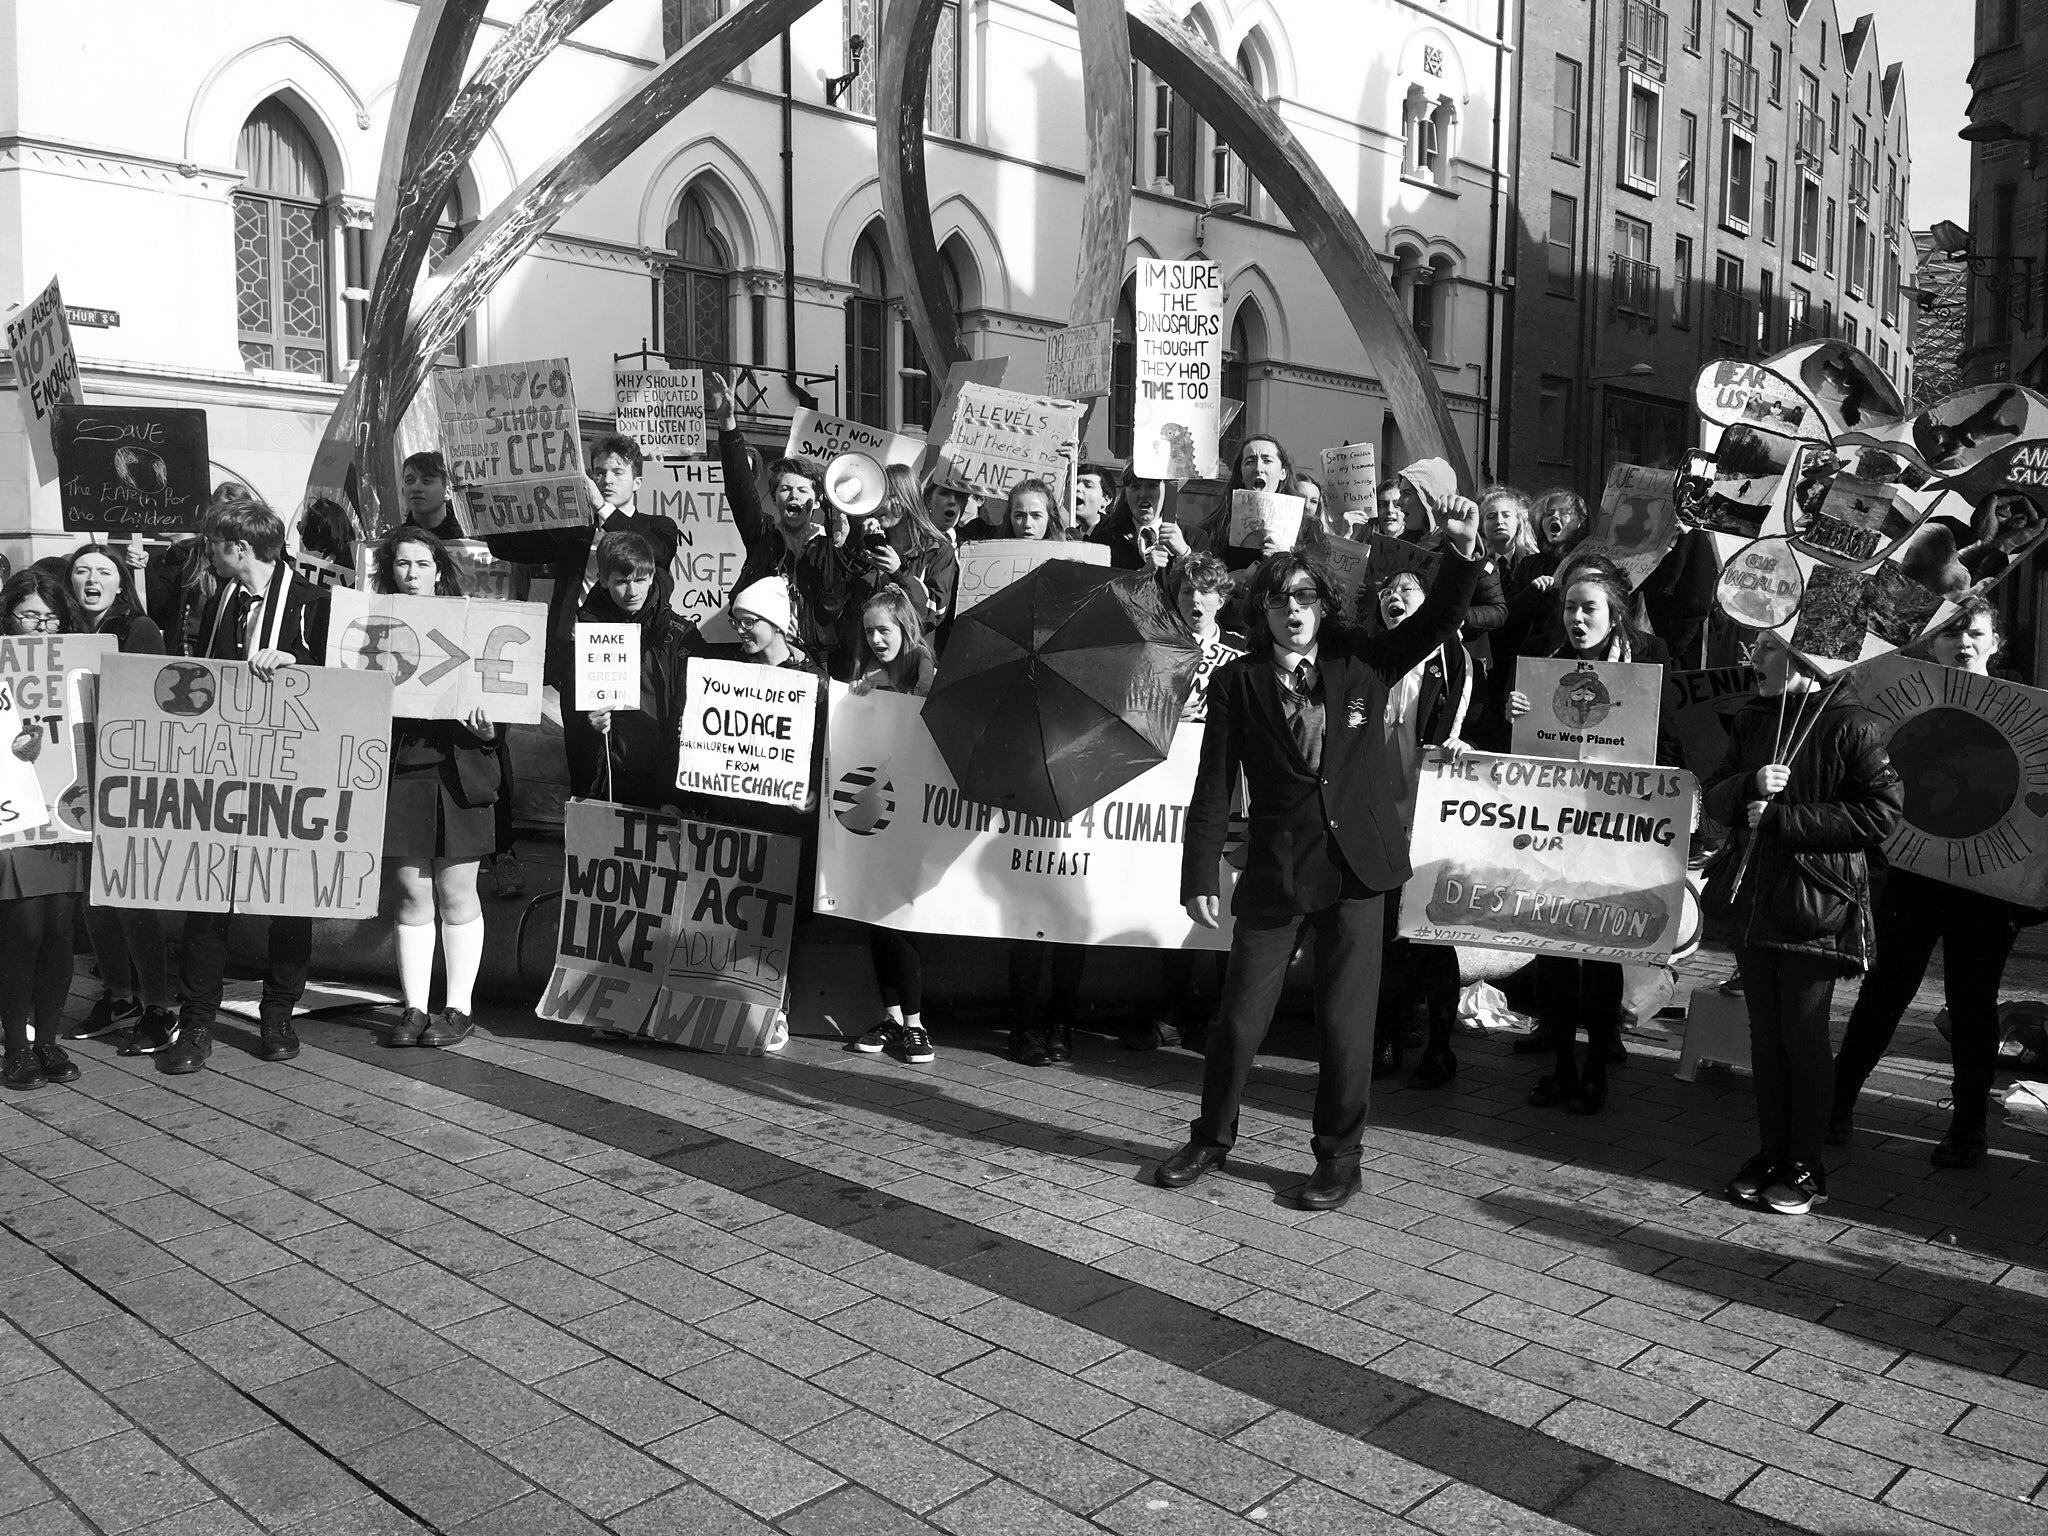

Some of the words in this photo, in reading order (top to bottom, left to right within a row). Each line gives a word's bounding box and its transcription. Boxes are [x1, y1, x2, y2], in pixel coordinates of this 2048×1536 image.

[1171, 265, 1219, 290] SURE
[1160, 293, 1197, 312] THE
[7, 319, 27, 349] I'M
[32, 284, 61, 329] ALREADY
[1138, 311, 1219, 336] DINOSAURS
[15, 318, 55, 387] HOT
[1144, 339, 1209, 356] THOUGHT
[30, 347, 78, 420] ENOUGH
[616, 374, 643, 388] WHY
[646, 375, 688, 389] SHOULD
[692, 376, 696, 387] I
[1141, 360, 1176, 376] THEY
[1179, 362, 1210, 380] HAD
[438, 371, 528, 405] WHY
[530, 369, 568, 400] GO
[617, 391, 639, 402] GET
[644, 390, 698, 402] EDUCATED
[1142, 380, 1174, 400] TIME
[1177, 382, 1208, 400] TOO
[1717, 388, 1747, 409] US
[445, 412, 479, 435] TO
[486, 404, 570, 434] SCHOOL
[617, 407, 645, 418] WHEN
[647, 405, 703, 419] POLITICIANS
[963, 403, 1048, 430] A-LEVELS
[640, 433, 700, 445] EDUCATED?
[648, 420, 686, 433] LISTEN
[689, 420, 701, 432] TO
[814, 420, 844, 437] ACT
[849, 429, 884, 448] NOW
[450, 443, 488, 458] WHEN
[490, 442, 499, 455] I
[827, 438, 851, 452] OR
[957, 428, 982, 446] but
[985, 433, 1031, 458] there's
[1039, 451, 1058, 463] no
[64, 474, 92, 496] The
[450, 458, 500, 485] CAN'T
[663, 465, 726, 484] THE
[946, 454, 1035, 490] PLANET
[466, 486, 579, 529] FUTURE
[1745, 553, 1778, 572] OUR
[1723, 568, 1799, 596] WORLD!
[589, 634, 625, 645] MAKE
[0, 637, 64, 674] ATE
[1577, 661, 1594, 671] It's
[587, 671, 627, 682] GREEN
[702, 676, 731, 695] YOU
[734, 687, 763, 700] WILL
[765, 688, 785, 703] DIE
[788, 690, 806, 703] OF
[1943, 668, 1973, 709] THE
[702, 707, 749, 737] OLD
[751, 713, 792, 740] AGE
[1537, 730, 1557, 741] Our
[1559, 731, 1584, 743] Wee
[1586, 734, 1625, 746] Planet
[100, 720, 302, 780] CLIMATE
[338, 735, 388, 790] IS
[726, 760, 760, 772] FROM
[737, 742, 767, 758] WILL
[769, 747, 796, 763] DIE
[679, 771, 741, 793] CLIMATE
[742, 776, 805, 800] CHANGE
[1429, 758, 1481, 782] THE
[1490, 761, 1652, 797] GOVERNMENT
[1657, 775, 1682, 798] IS
[99, 776, 353, 843] CHANGING!
[922, 783, 992, 833] YOUTH
[1080, 803, 1095, 838] 4
[1440, 800, 1549, 832] FOSSIL
[1557, 807, 1676, 847] FUELLING
[614, 809, 678, 863] IF
[688, 823, 768, 884] YOU
[1513, 833, 1564, 852] OUR
[1886, 826, 1932, 868] THE
[1947, 818, 2032, 878] PLANET
[97, 834, 172, 901] WHY
[176, 841, 300, 905] AREN'T
[311, 849, 375, 910] WE?
[1010, 848, 1091, 877] BELFAST
[567, 855, 688, 915] WON'T
[692, 878, 793, 938] ACT
[1446, 880, 1652, 940] DESTRUCTION
[560, 899, 662, 973] LIKE
[669, 928, 784, 982] ADULTS
[1491, 935, 1556, 950] STRIKE
[542, 967, 631, 1027] WE
